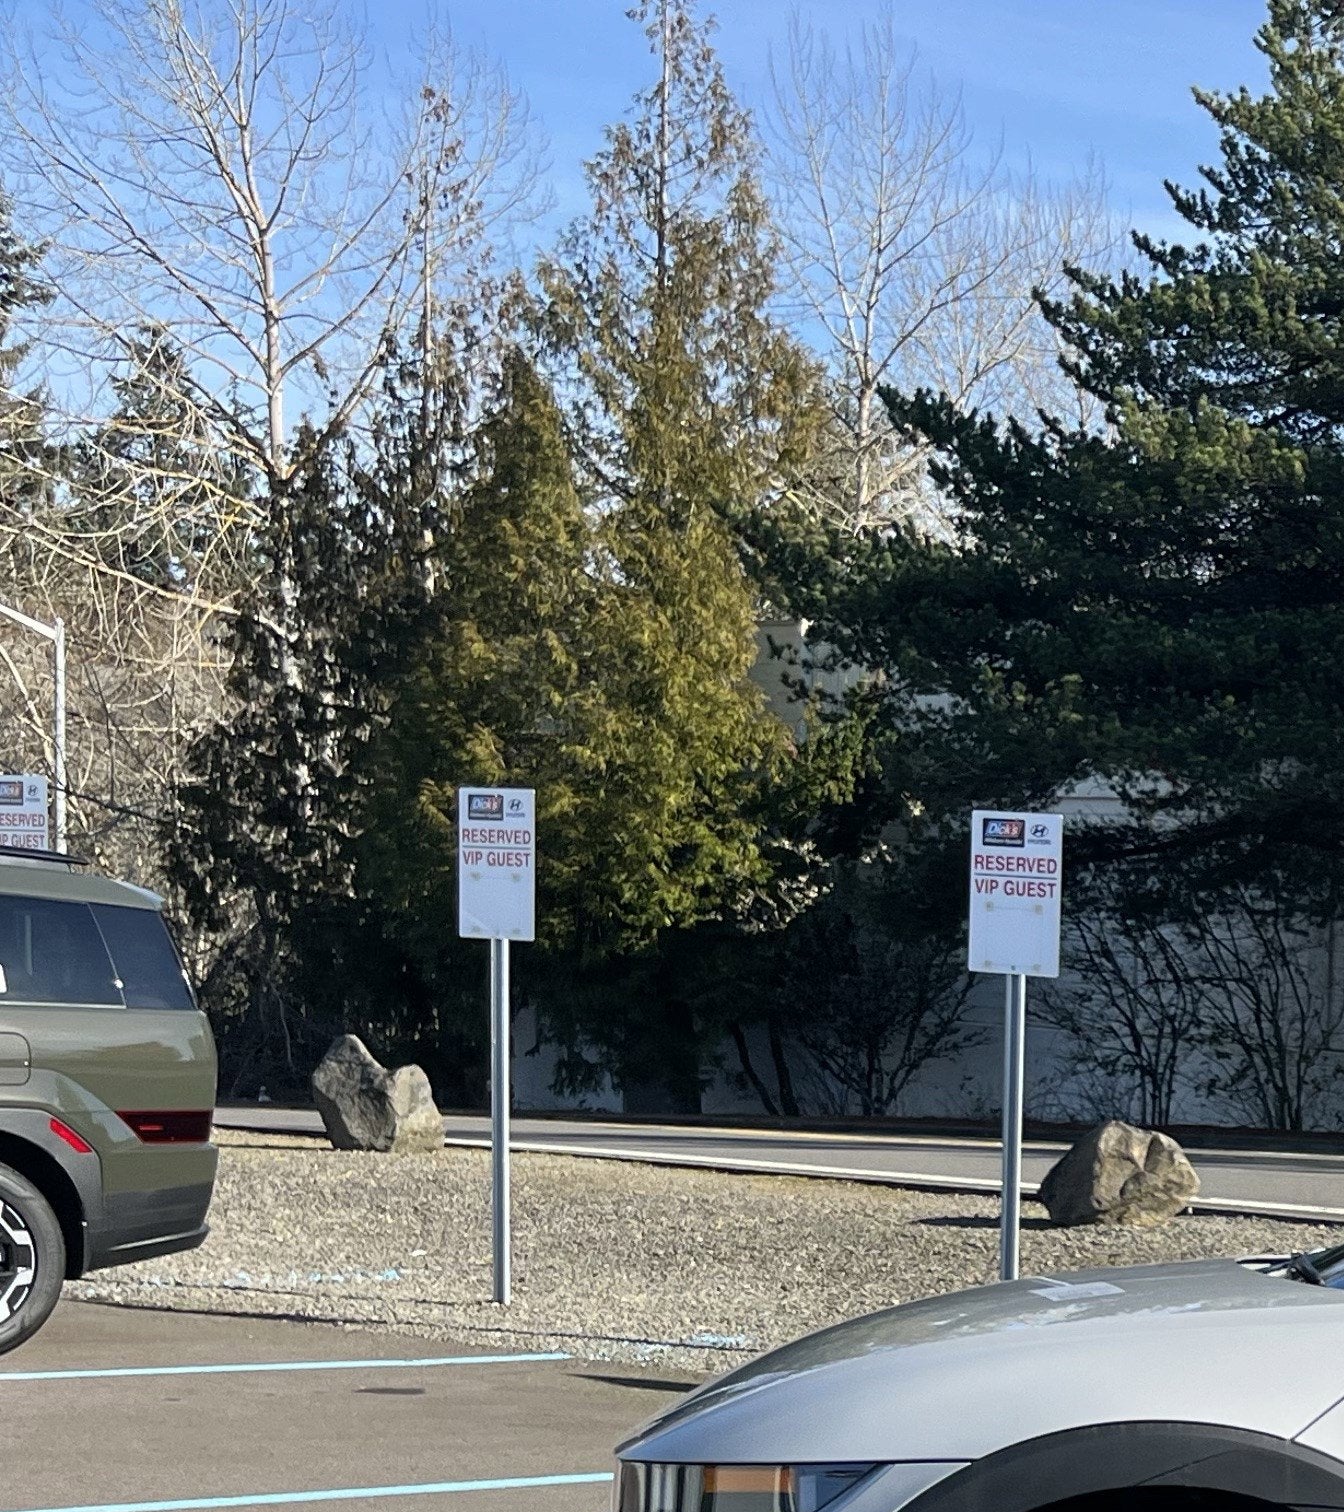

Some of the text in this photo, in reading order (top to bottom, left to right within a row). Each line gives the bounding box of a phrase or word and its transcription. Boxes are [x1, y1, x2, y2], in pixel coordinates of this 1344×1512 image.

[0, 813, 45, 827] ESERVED
[11, 833, 45, 848] GUEST
[462, 828, 531, 844] RESERVED
[462, 850, 531, 867] VIP GUEST
[974, 854, 1058, 874] RESERVED
[974, 878, 1057, 898] VIP GUEST
